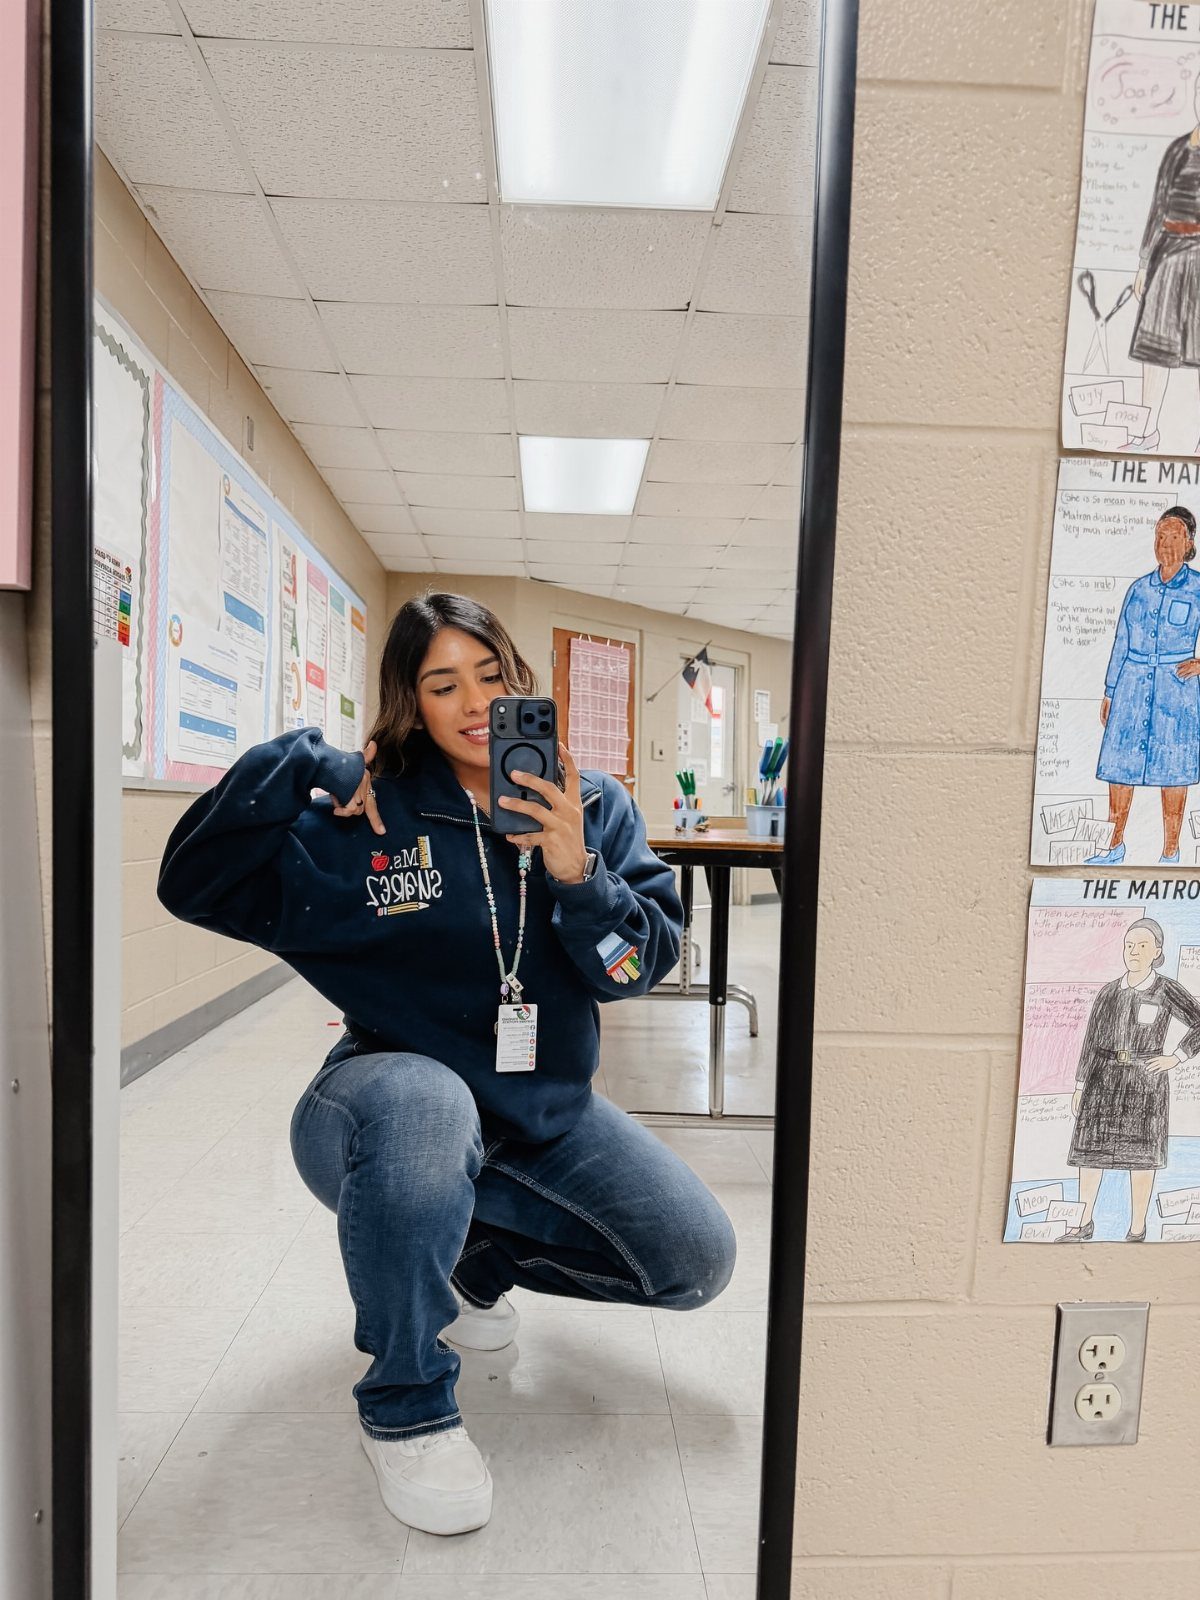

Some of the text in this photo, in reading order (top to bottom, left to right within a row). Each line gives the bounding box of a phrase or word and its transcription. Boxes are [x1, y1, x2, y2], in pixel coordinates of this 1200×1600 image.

[1149, 3, 1189, 30] THE
[1111, 460, 1148, 483] THE
[1104, 497, 1126, 506] mean
[1049, 802, 1087, 830] MEAN
[1083, 879, 1200, 900] THE MATRO
[1023, 1195, 1048, 1210] Mean
